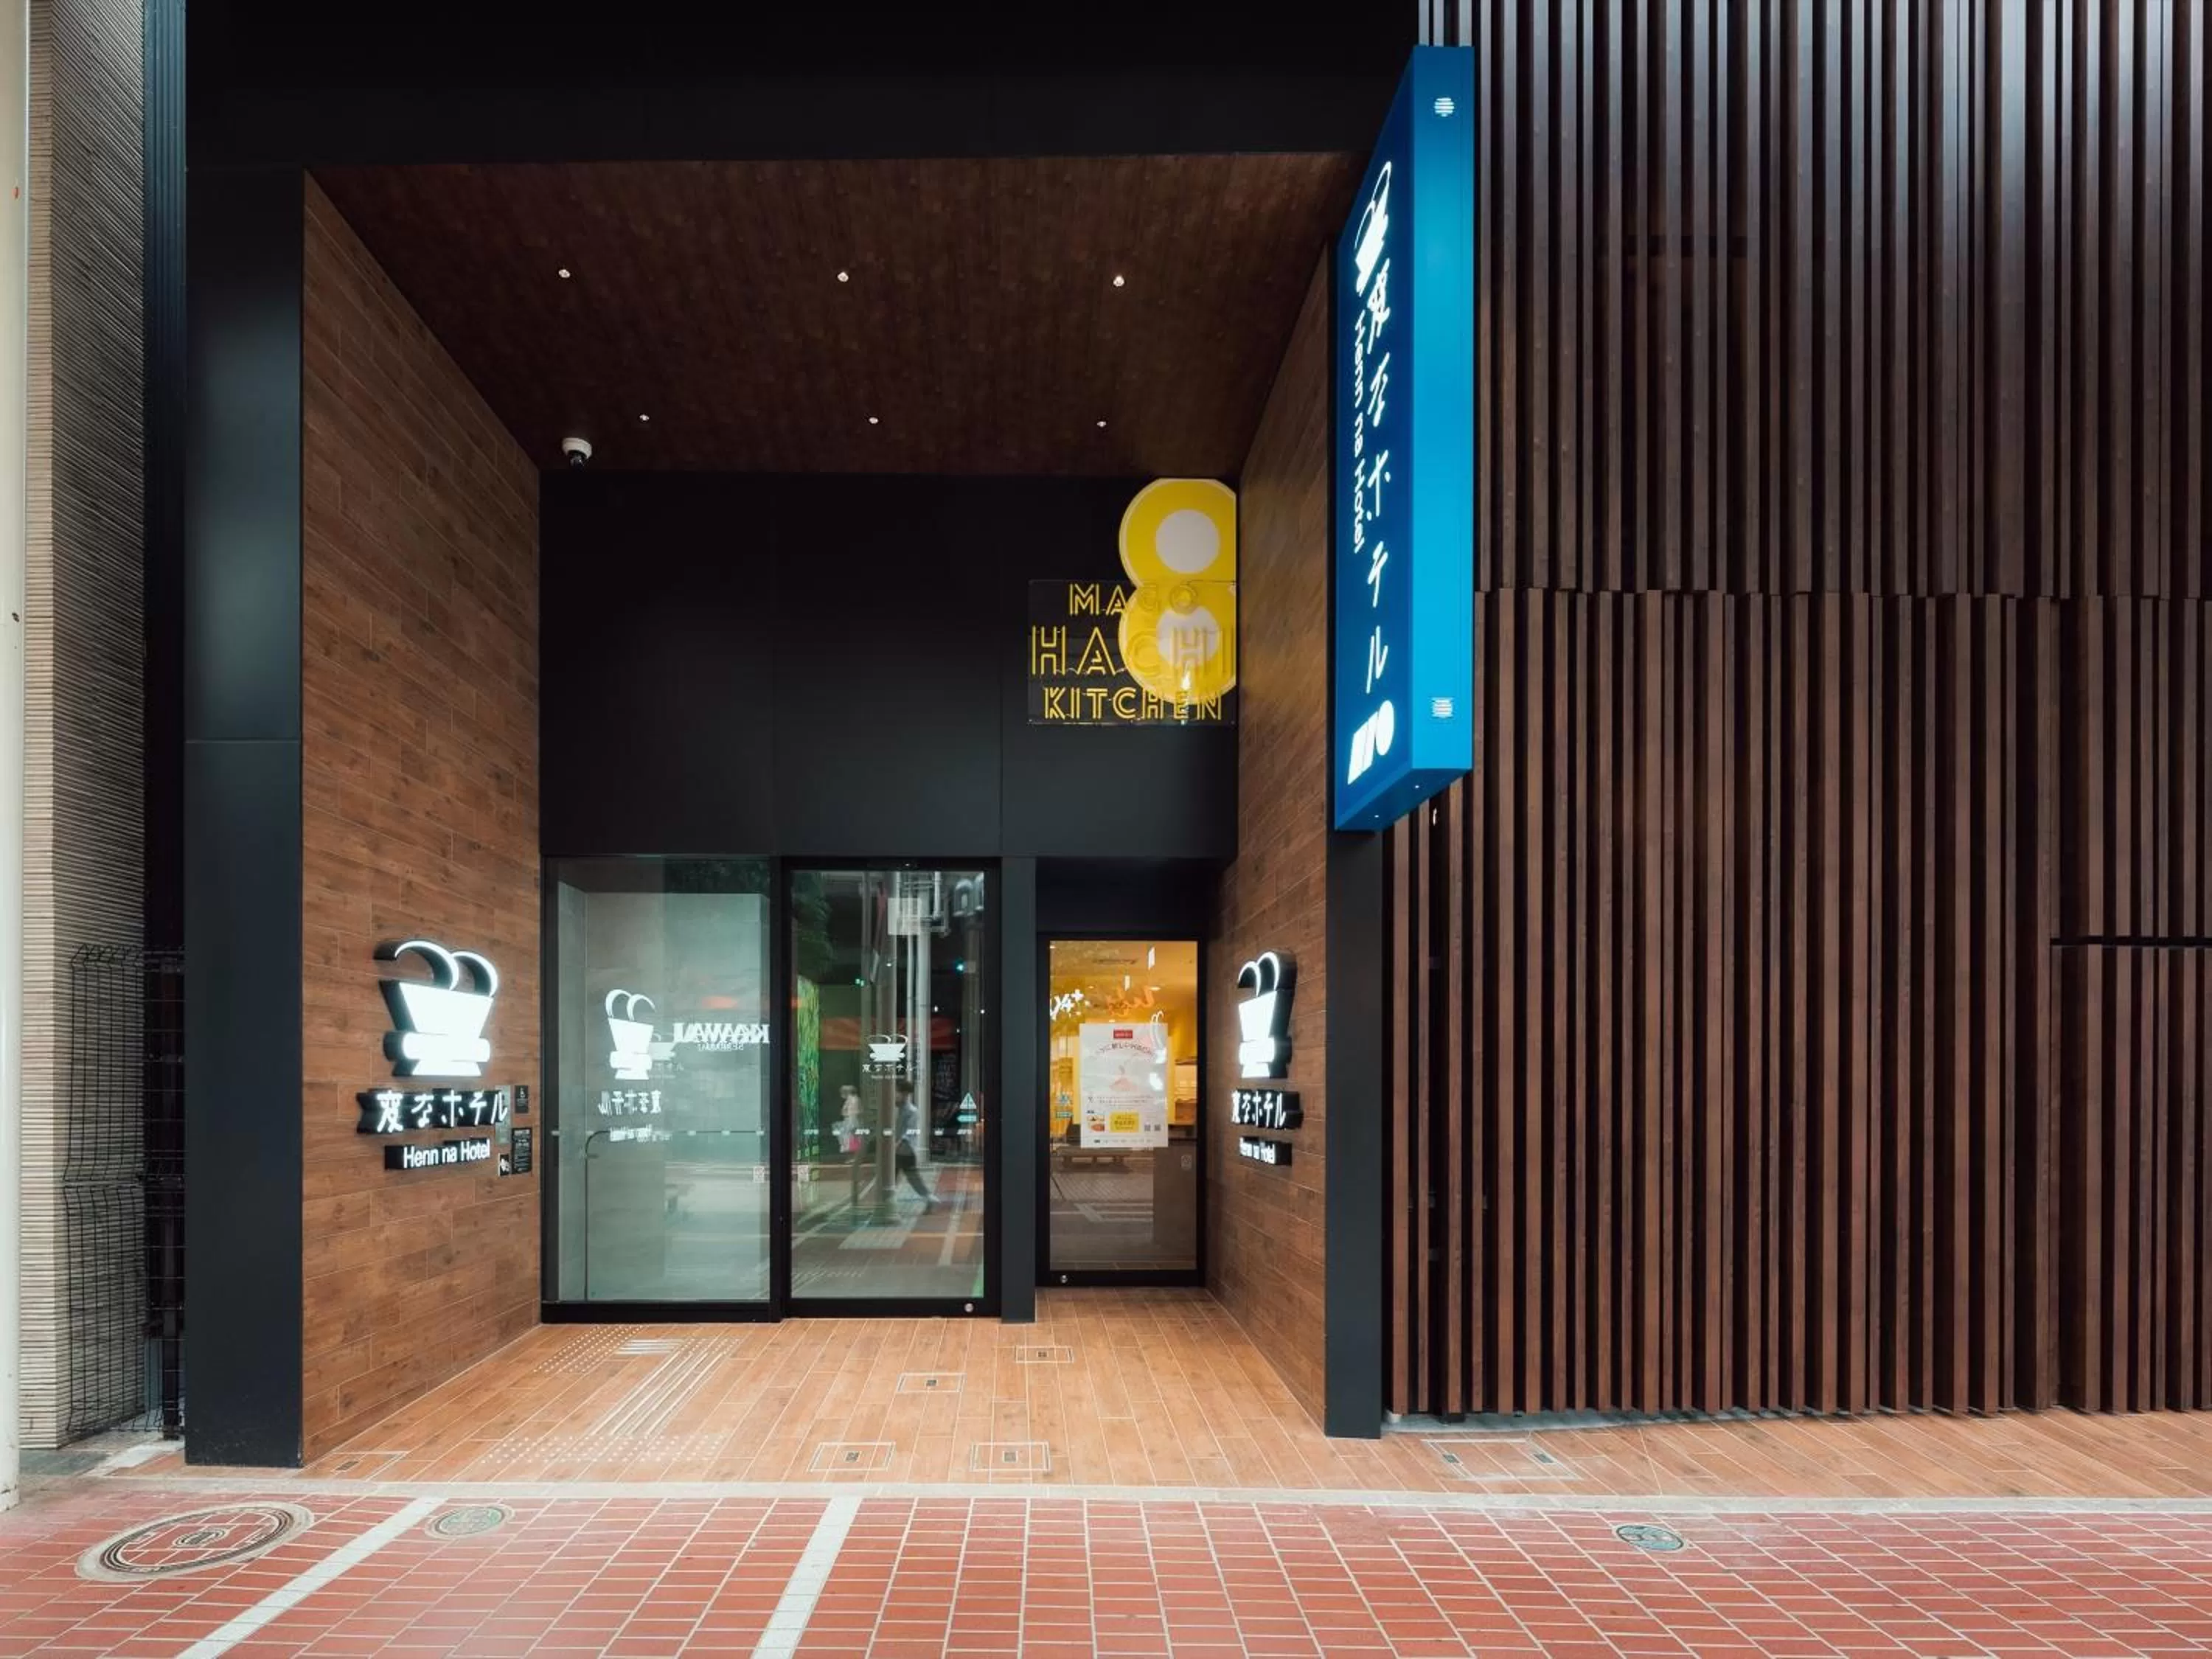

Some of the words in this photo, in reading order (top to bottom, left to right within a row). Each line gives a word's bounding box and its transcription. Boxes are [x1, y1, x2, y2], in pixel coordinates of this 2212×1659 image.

[1354, 308, 1366, 408] Henn
[1354, 411, 1364, 458] na
[1366, 258, 1391, 694] 変なホテル
[1354, 458, 1366, 554] Hotel
[1043, 686, 1222, 721] KITCHEN
[376, 1089, 508, 1133] 変なホテル
[403, 1146, 439, 1169] Henn
[442, 1147, 457, 1164] na
[461, 1138, 491, 1161] Hotel
